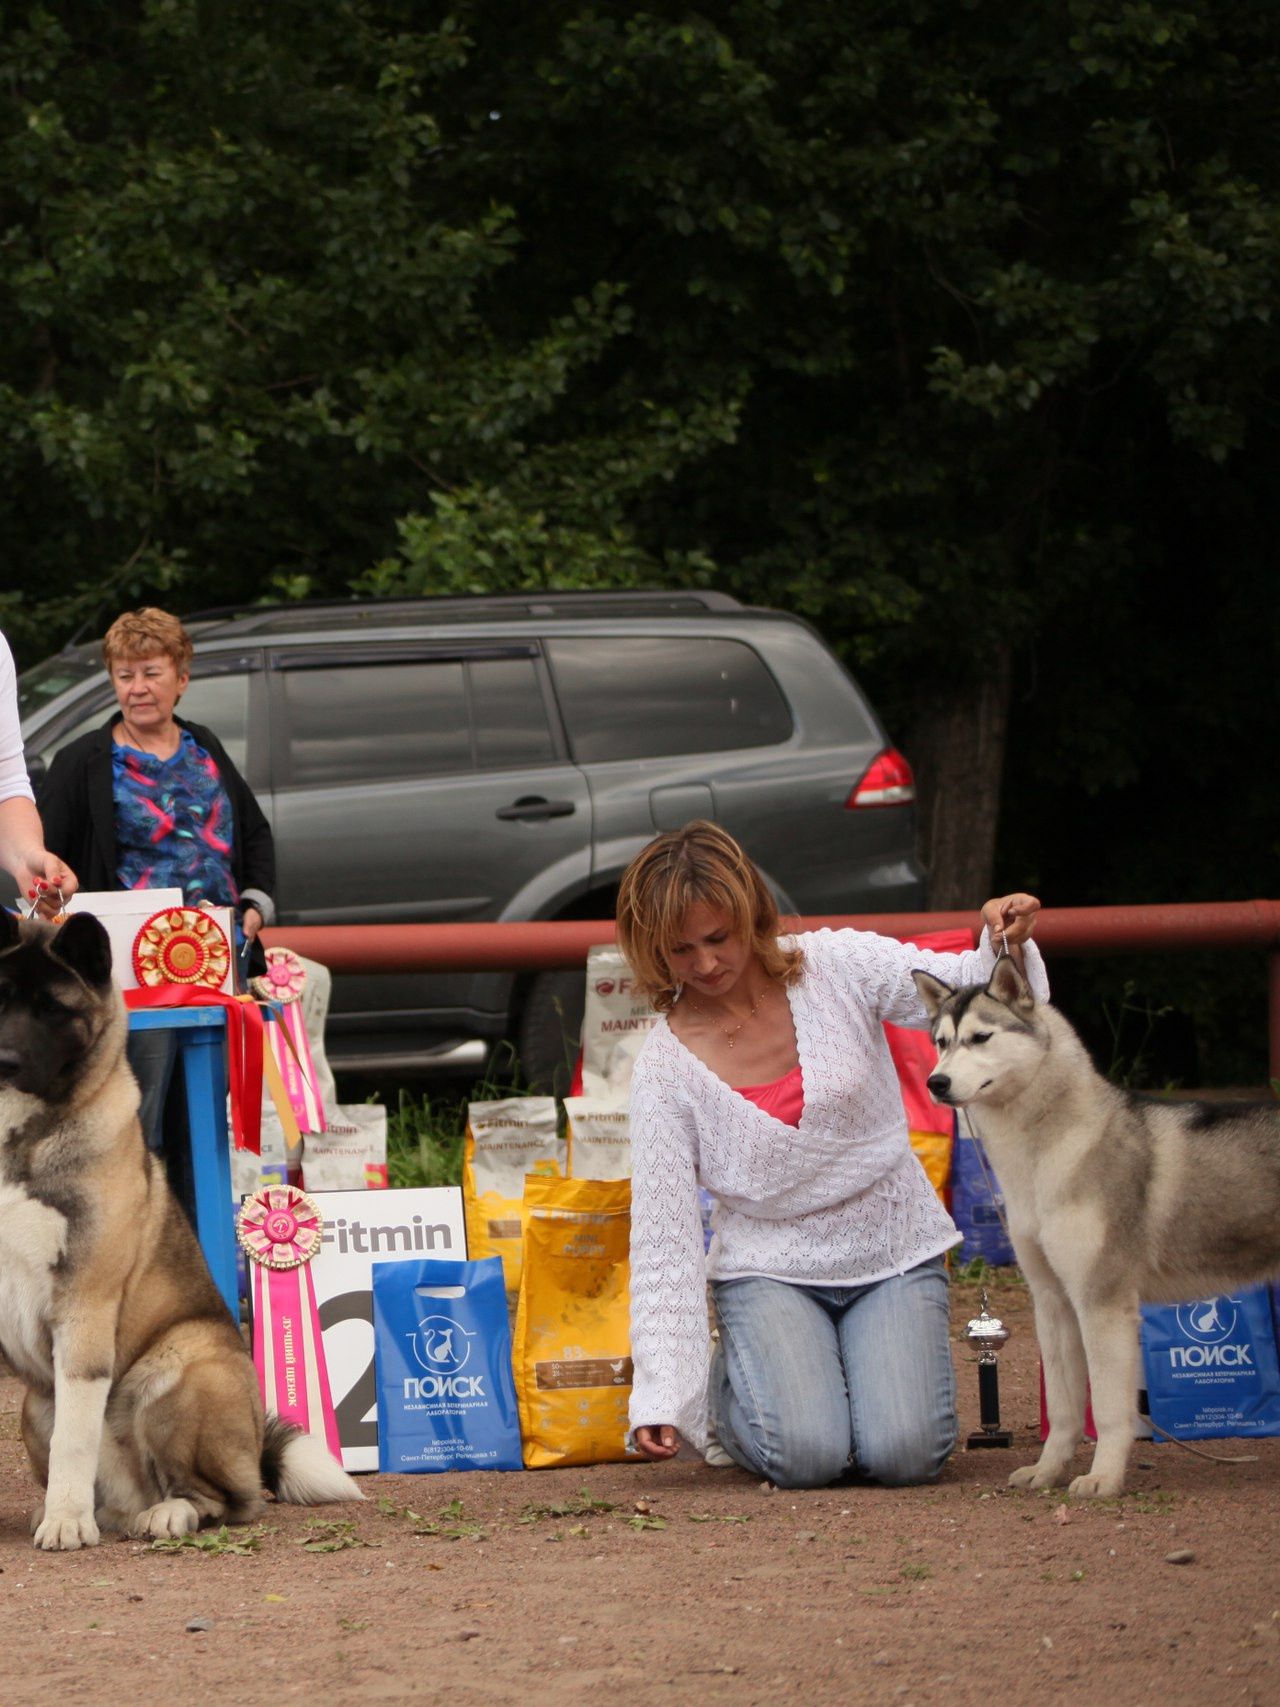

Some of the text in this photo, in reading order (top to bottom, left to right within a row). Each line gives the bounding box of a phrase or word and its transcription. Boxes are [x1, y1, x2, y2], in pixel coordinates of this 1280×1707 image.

[324, 1122, 358, 1136] itmin
[282, 1316, 298, 1407] ЛУЧШИЙ ЩЕНОК
[1169, 1344, 1253, 1368] ПОИСК
[404, 1376, 485, 1399] ПОИСК
[447, 1401, 488, 1409] ВЕТЕРИНАРНАЯ
